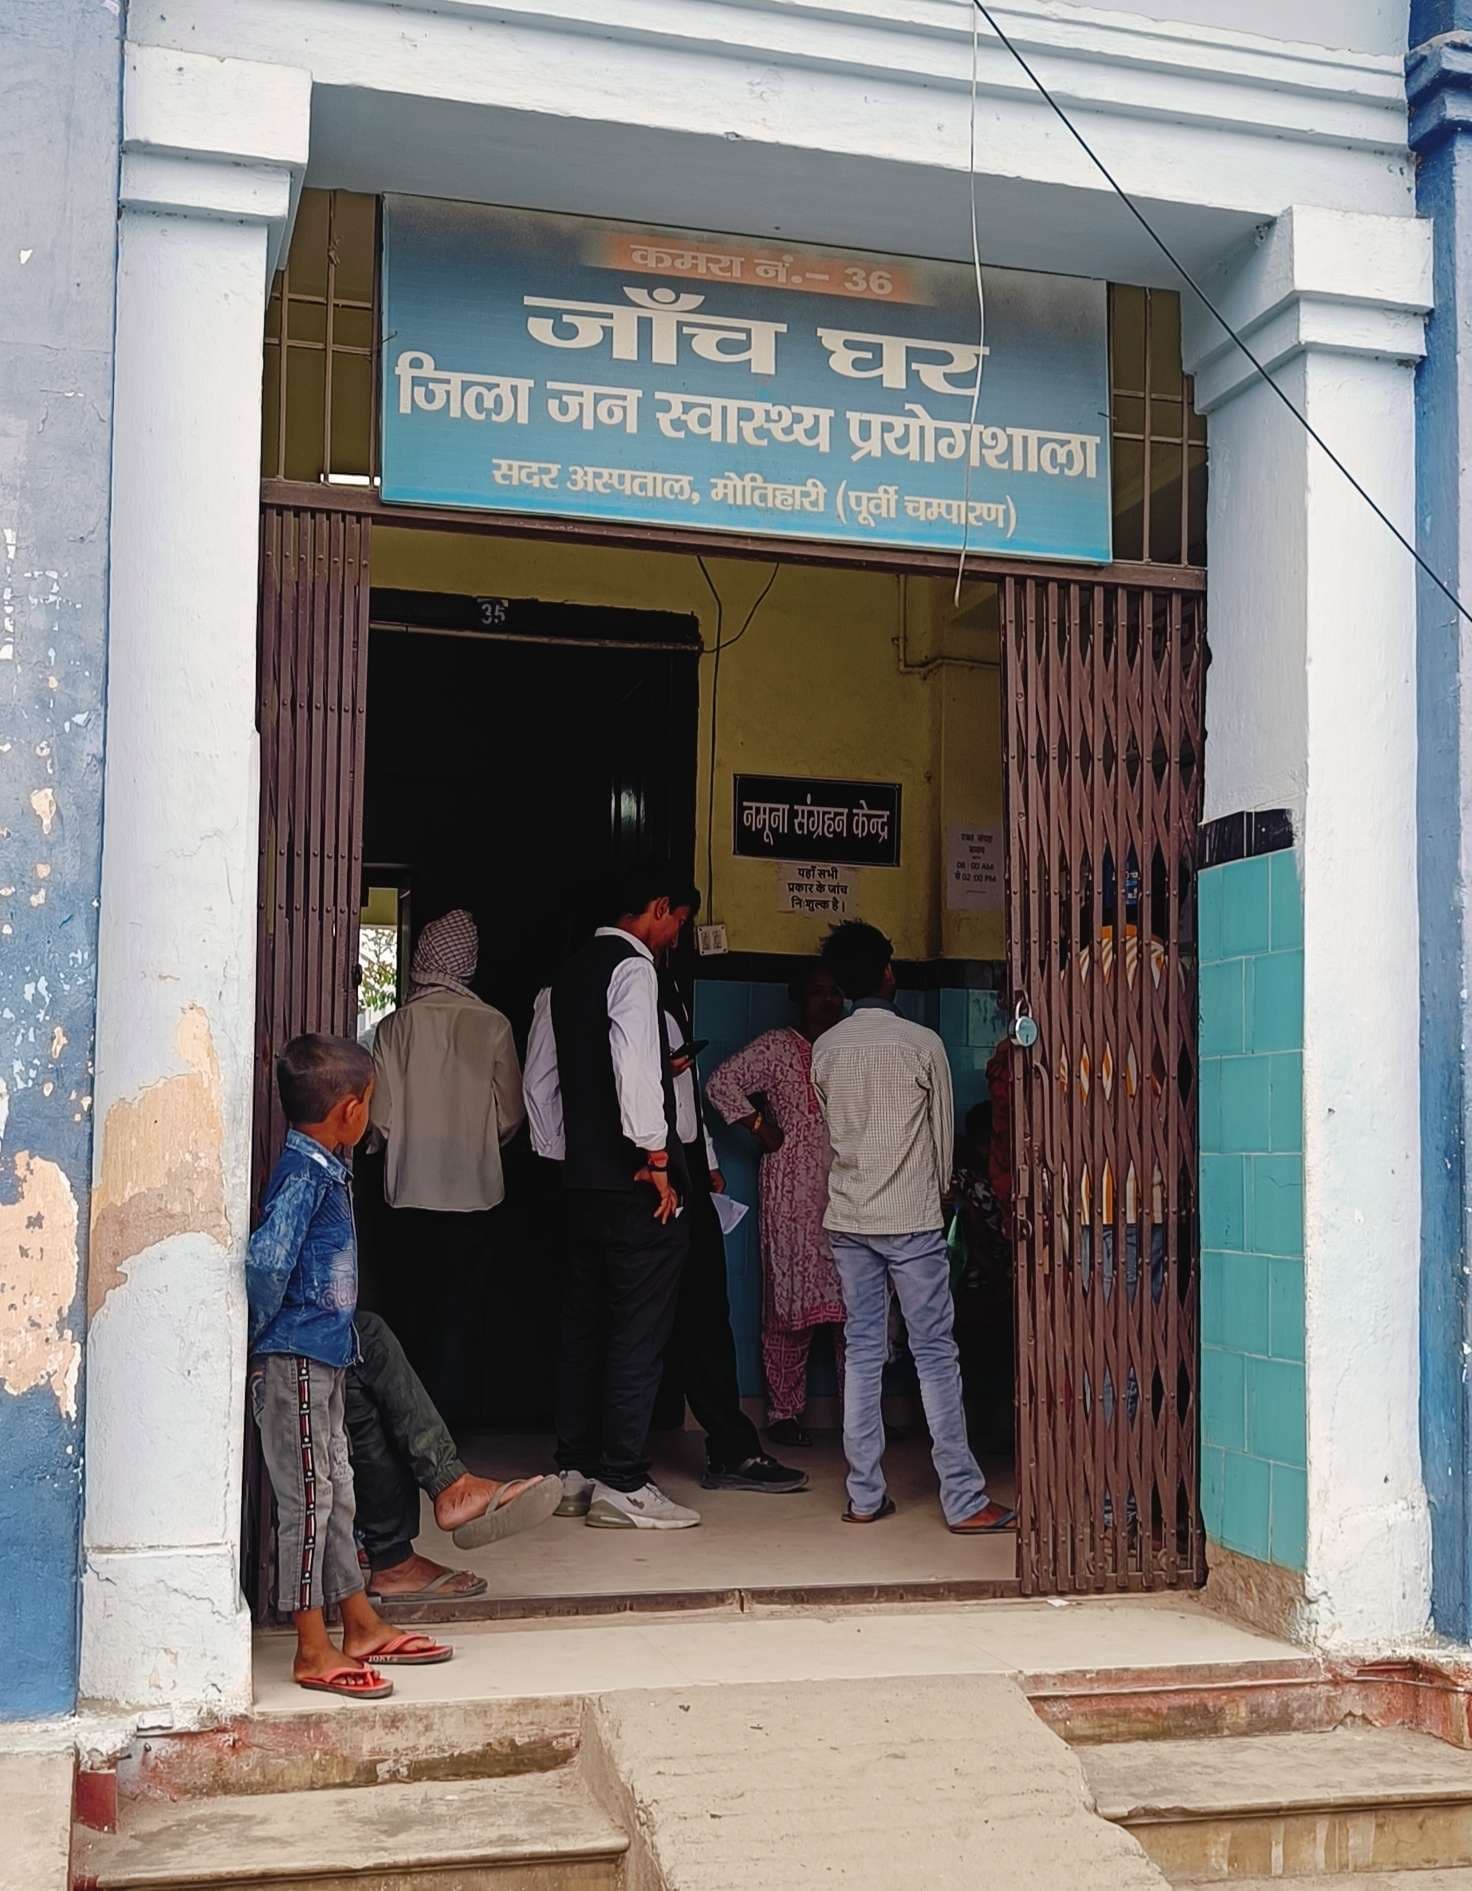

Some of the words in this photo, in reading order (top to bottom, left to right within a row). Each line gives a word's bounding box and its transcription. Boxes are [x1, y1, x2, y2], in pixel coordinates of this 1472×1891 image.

[630, 244, 744, 278] कमरा
[844, 267, 893, 295] 36
[524, 286, 787, 376] जाँच
[817, 327, 990, 397] घर
[394, 351, 534, 425] जिला
[547, 381, 642, 434] जन
[655, 391, 835, 453] स्वास्थ्य
[846, 403, 1100, 479] प्रयोगशाला
[492, 458, 561, 489] सदर
[567, 465, 700, 505] अस्पताल,
[710, 472, 827, 512] मोतिहारी
[836, 480, 898, 527] (पूर्वी
[904, 495, 1017, 539] चम्पारण)
[743, 801, 790, 845] नमूना
[793, 793, 848, 839] संग्रहन
[852, 799, 890, 843] केन्द्र
[787, 882, 814, 893] प्रकार
[815, 881, 826, 893] के
[817, 866, 838, 880] सभी
